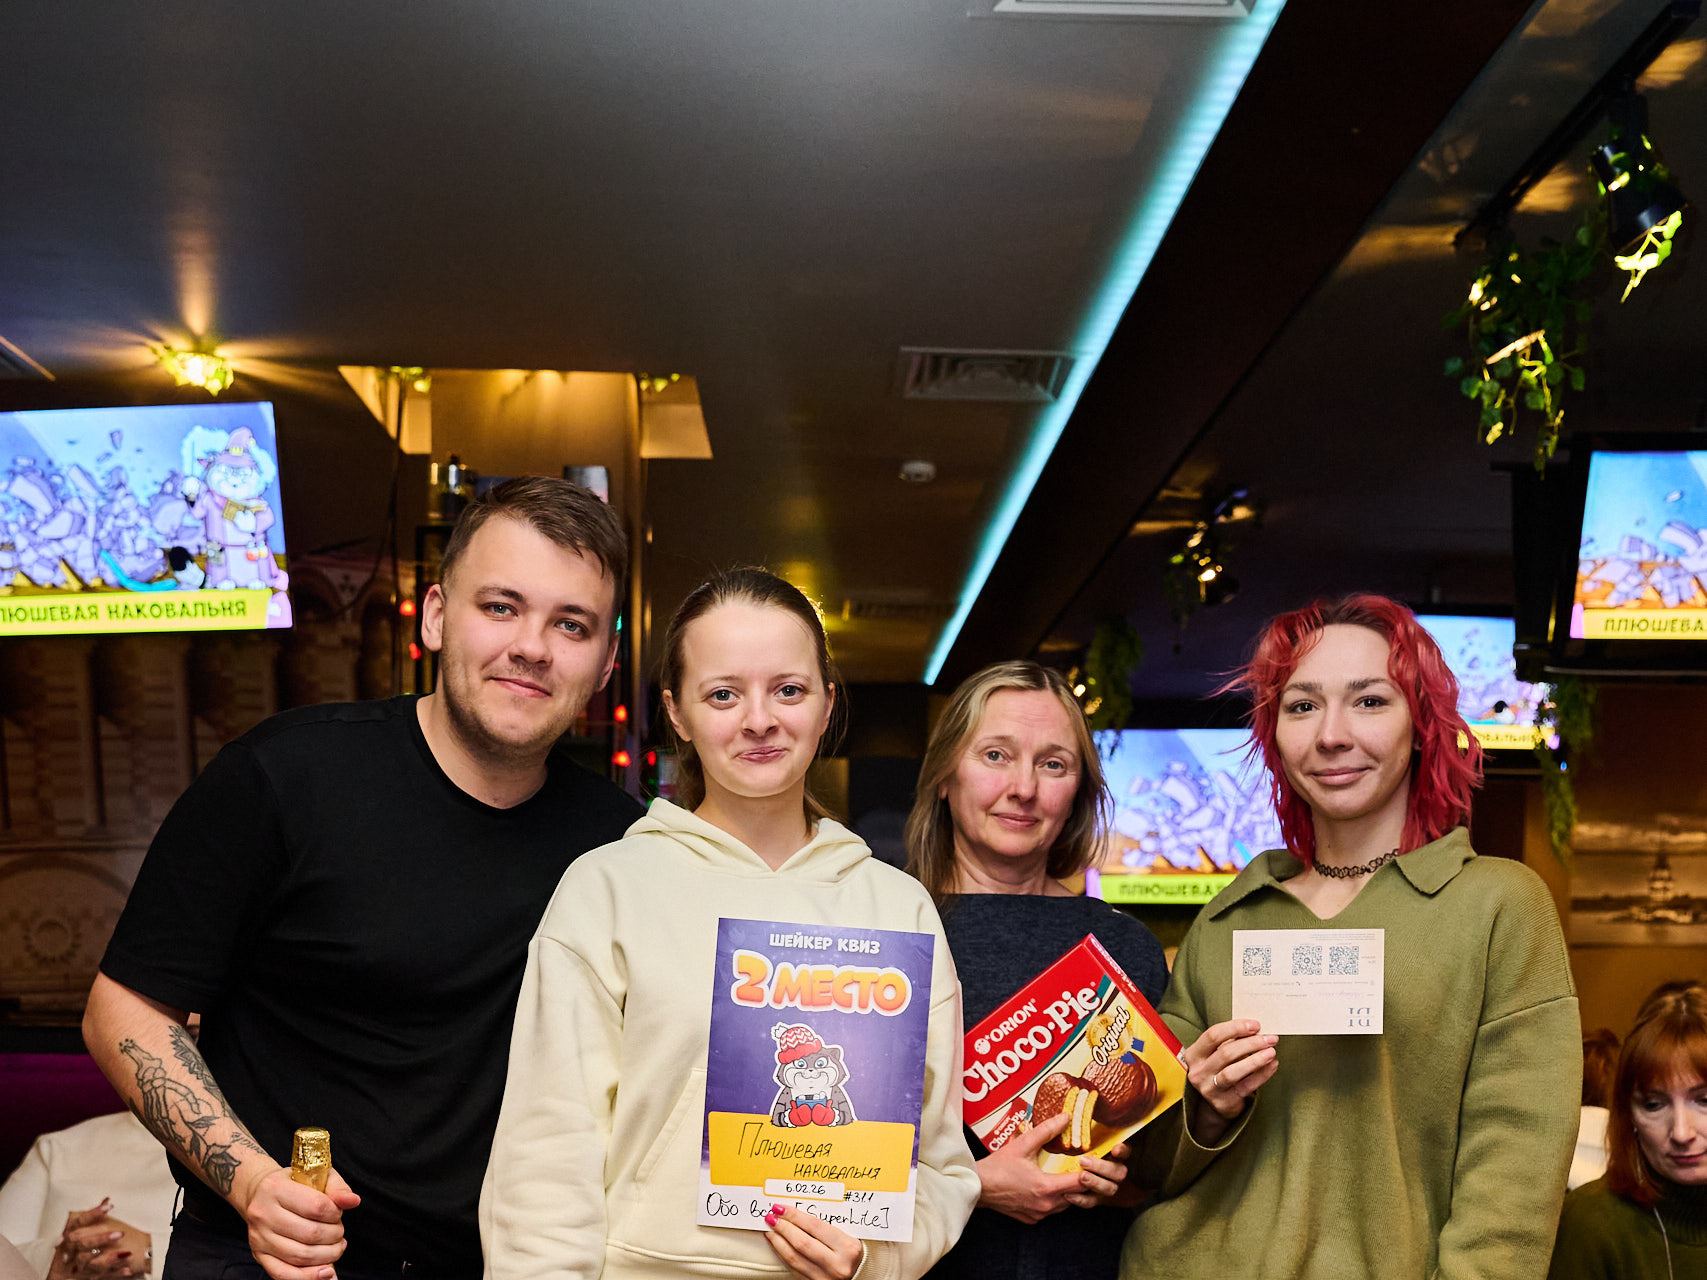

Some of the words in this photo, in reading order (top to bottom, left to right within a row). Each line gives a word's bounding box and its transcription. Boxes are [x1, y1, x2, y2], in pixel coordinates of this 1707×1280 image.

[108, 600, 247, 620] НАКОВАЛЬНЯ
[1604, 618, 1707, 632] ПЛЮШЕВА
[769, 932, 833, 951] ШЕЙКЕР
[837, 938, 881, 954] КВИЗ
[733, 952, 770, 1005] 2
[771, 964, 910, 1014] МЕСТО
[989, 1000, 1038, 1042] ORION
[1091, 1005, 1131, 1066] Original
[785, 1182, 826, 1195] 6.02.26
